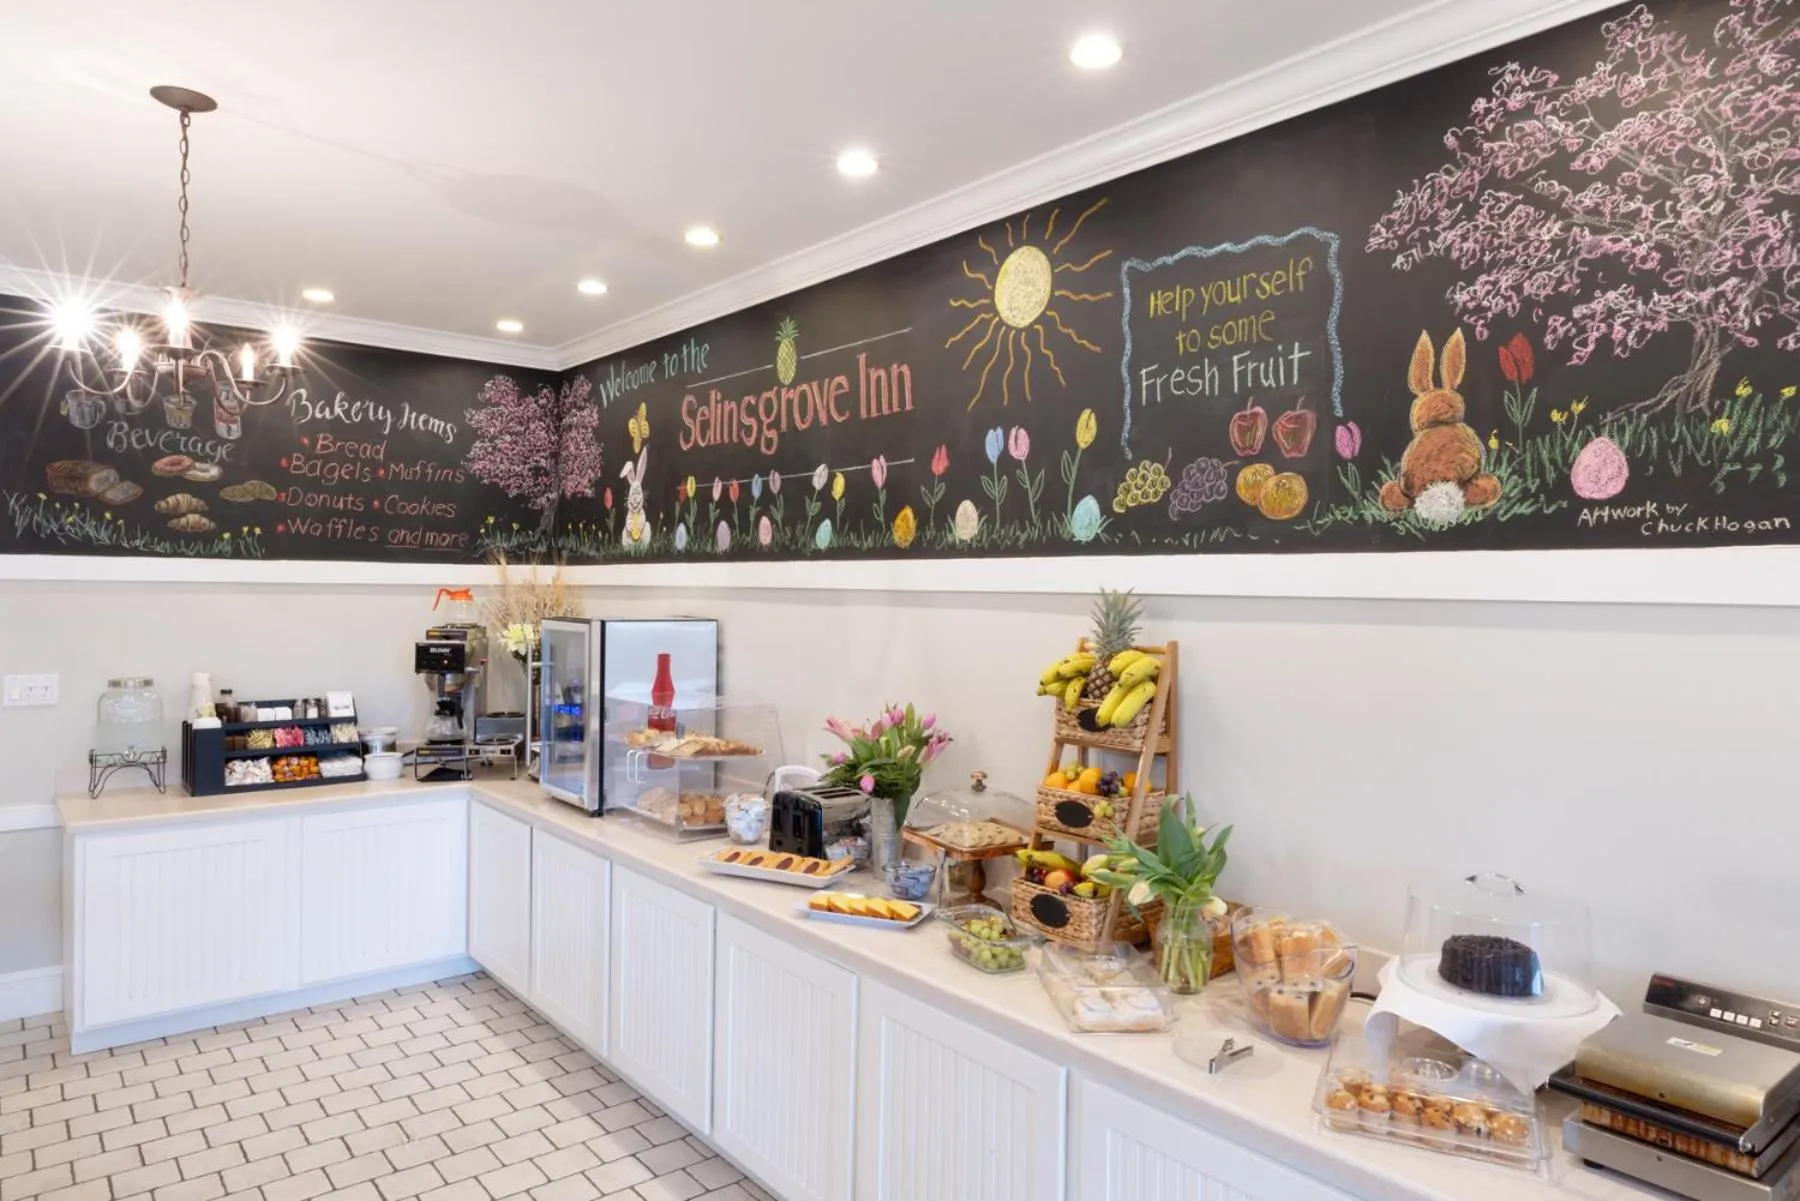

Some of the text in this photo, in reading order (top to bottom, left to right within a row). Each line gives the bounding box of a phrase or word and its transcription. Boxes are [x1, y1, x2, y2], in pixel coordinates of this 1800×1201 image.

[1149, 257, 1314, 322] Help yourself
[1175, 309, 1276, 356] to some
[599, 337, 710, 409] Welcome to the
[1139, 341, 1312, 406] Fresh Fruit
[285, 388, 457, 444] Bakery Items
[679, 351, 915, 456] Selinsgrove Inn
[106, 420, 236, 465] Beverage
[315, 433, 388, 461] Bread
[289, 452, 465, 486] Bagels Muffins
[286, 486, 457, 518] Donuts Cookies
[1577, 500, 1688, 528] Artwork by
[287, 517, 470, 548] Waffles and more
